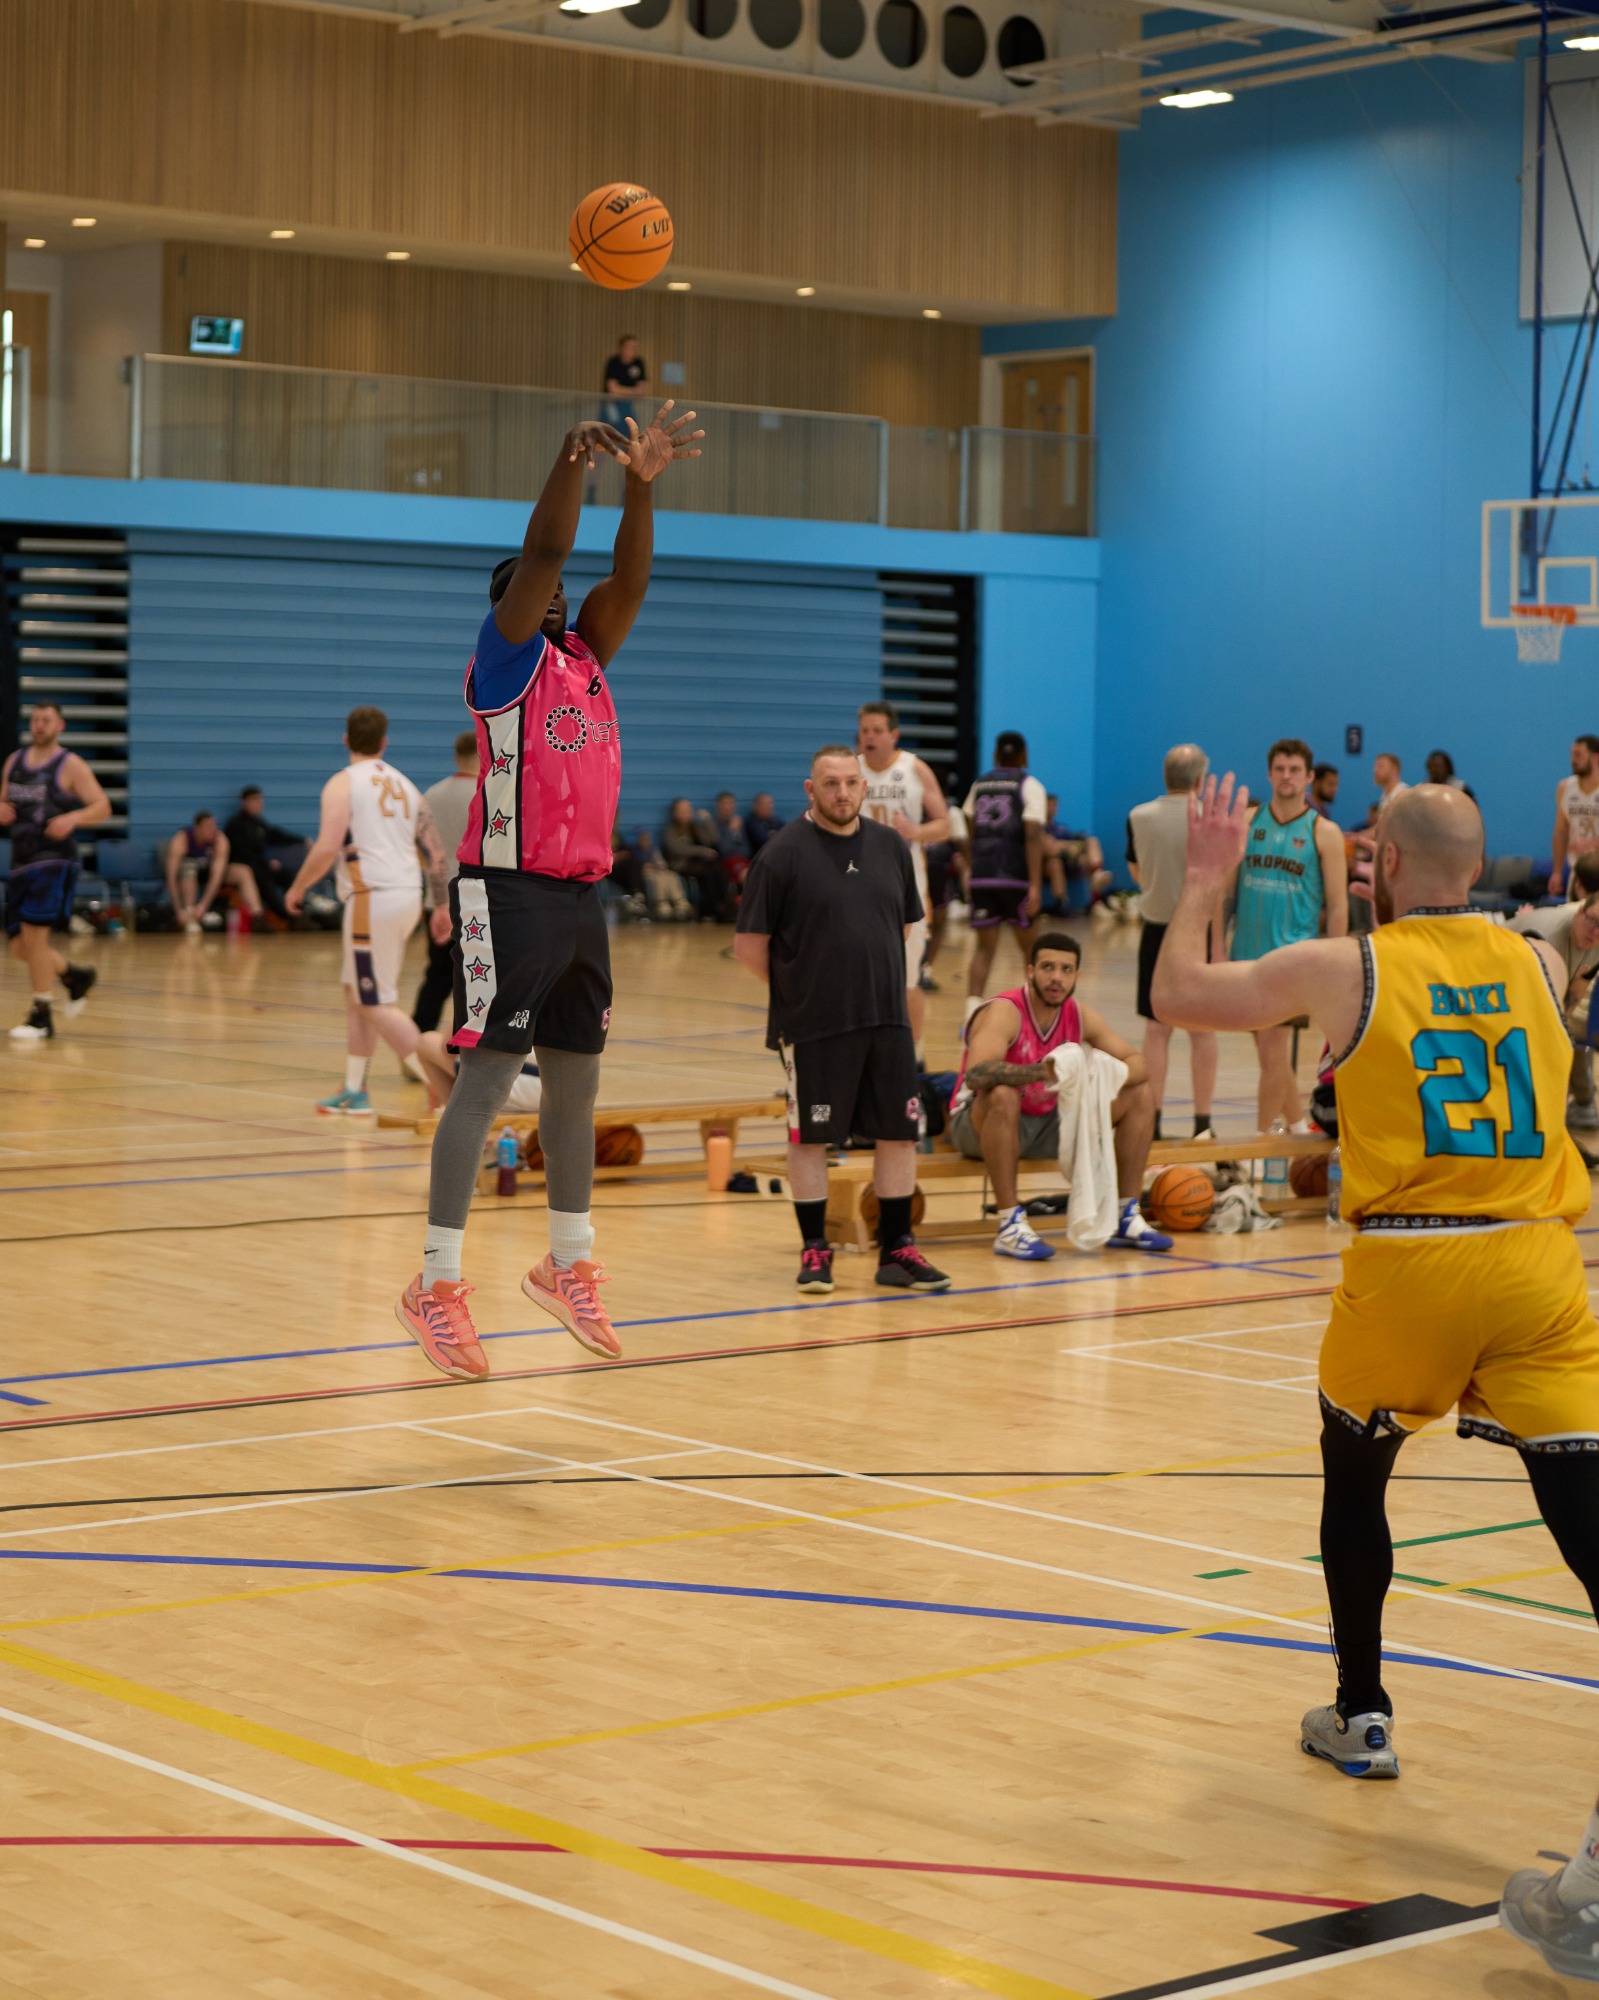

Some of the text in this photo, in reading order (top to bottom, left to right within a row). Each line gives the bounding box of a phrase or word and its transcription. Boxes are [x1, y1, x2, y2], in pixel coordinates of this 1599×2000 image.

[585, 674, 603, 697] 6
[371, 775, 410, 819] 24
[1245, 854, 1306, 878] TROPICS
[1427, 981, 1510, 1016] BOKI
[1410, 1026, 1545, 1159] 21
